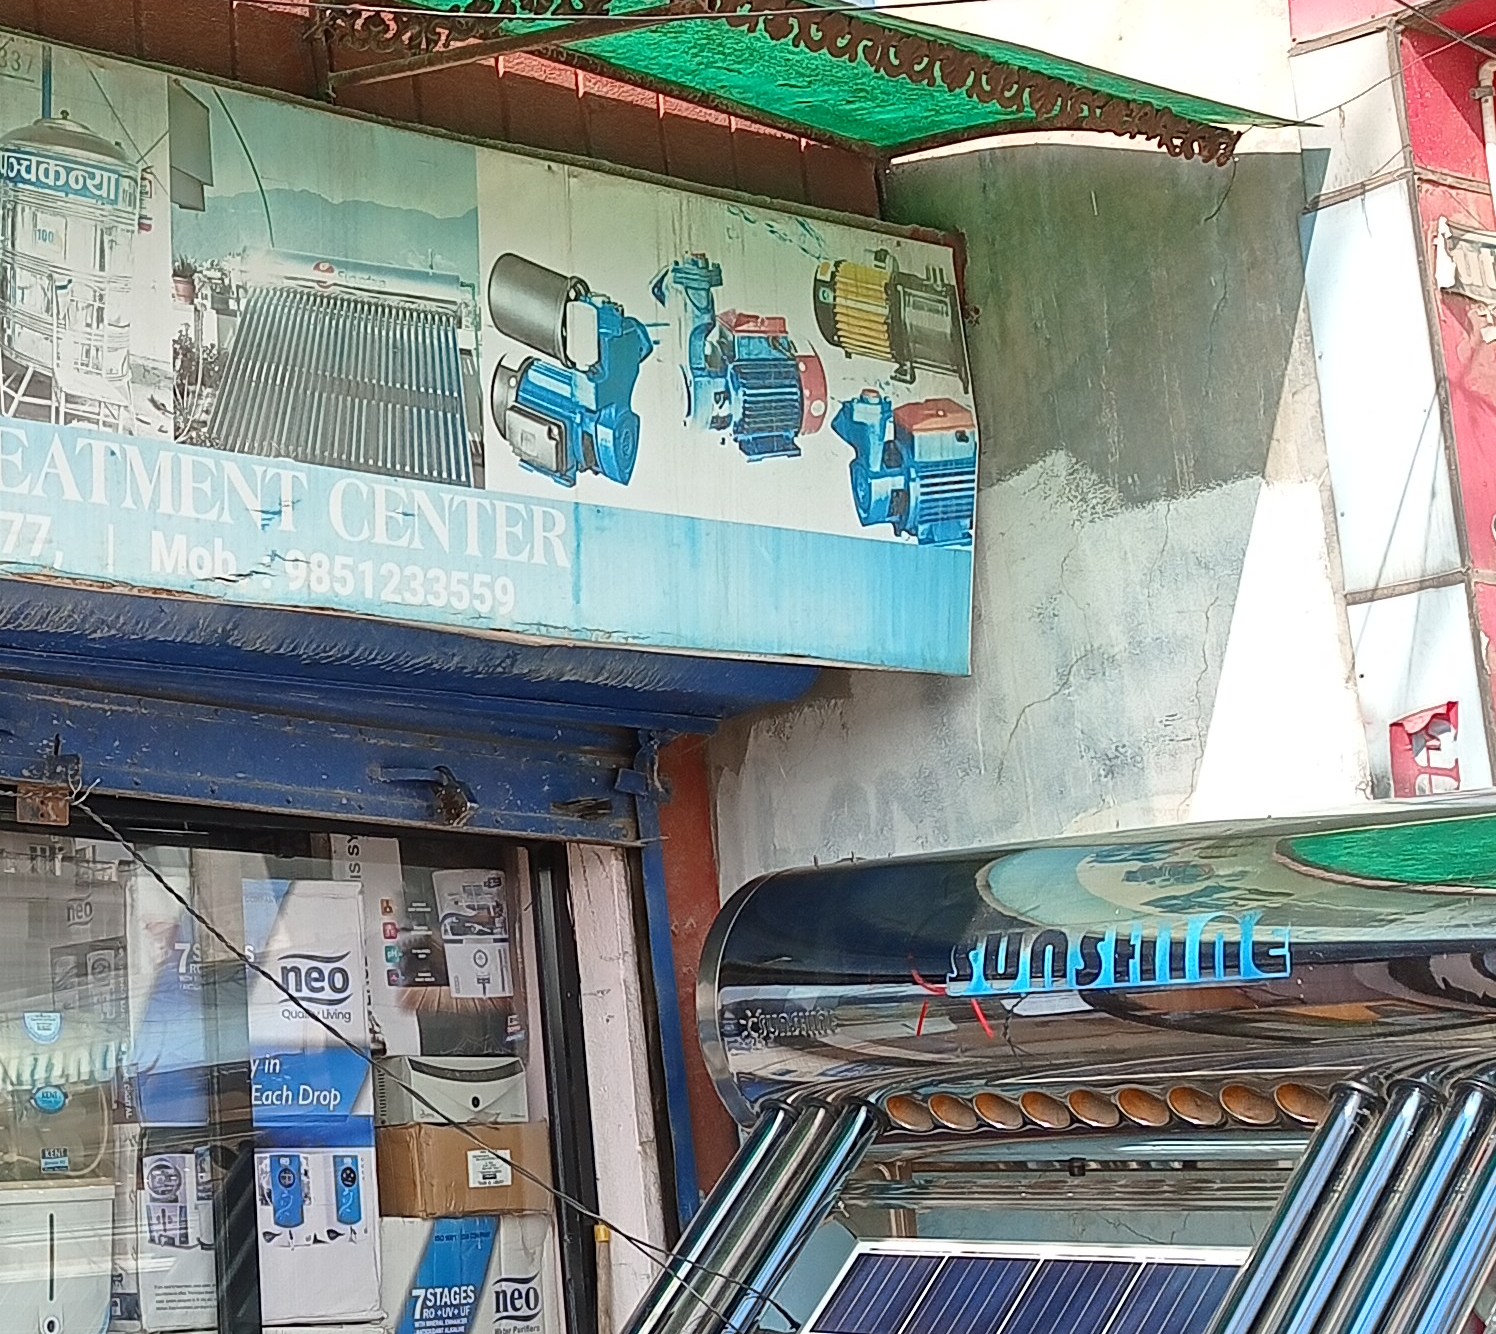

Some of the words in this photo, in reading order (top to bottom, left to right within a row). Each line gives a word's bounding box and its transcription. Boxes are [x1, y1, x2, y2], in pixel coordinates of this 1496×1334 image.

[328, 476, 572, 568] CENTER
[284, 549, 515, 615] 9851233559
[66, 901, 94, 923] neo
[280, 965, 350, 994] neo
[264, 1054, 280, 1073] in
[252, 1084, 292, 1105] Each
[299, 1084, 341, 1111] Drop
[412, 1289, 426, 1320] 7
[426, 1285, 475, 1307] STAGES
[423, 1308, 435, 1319] RO
[460, 1304, 471, 1316] UF
[494, 1286, 540, 1314] neo
